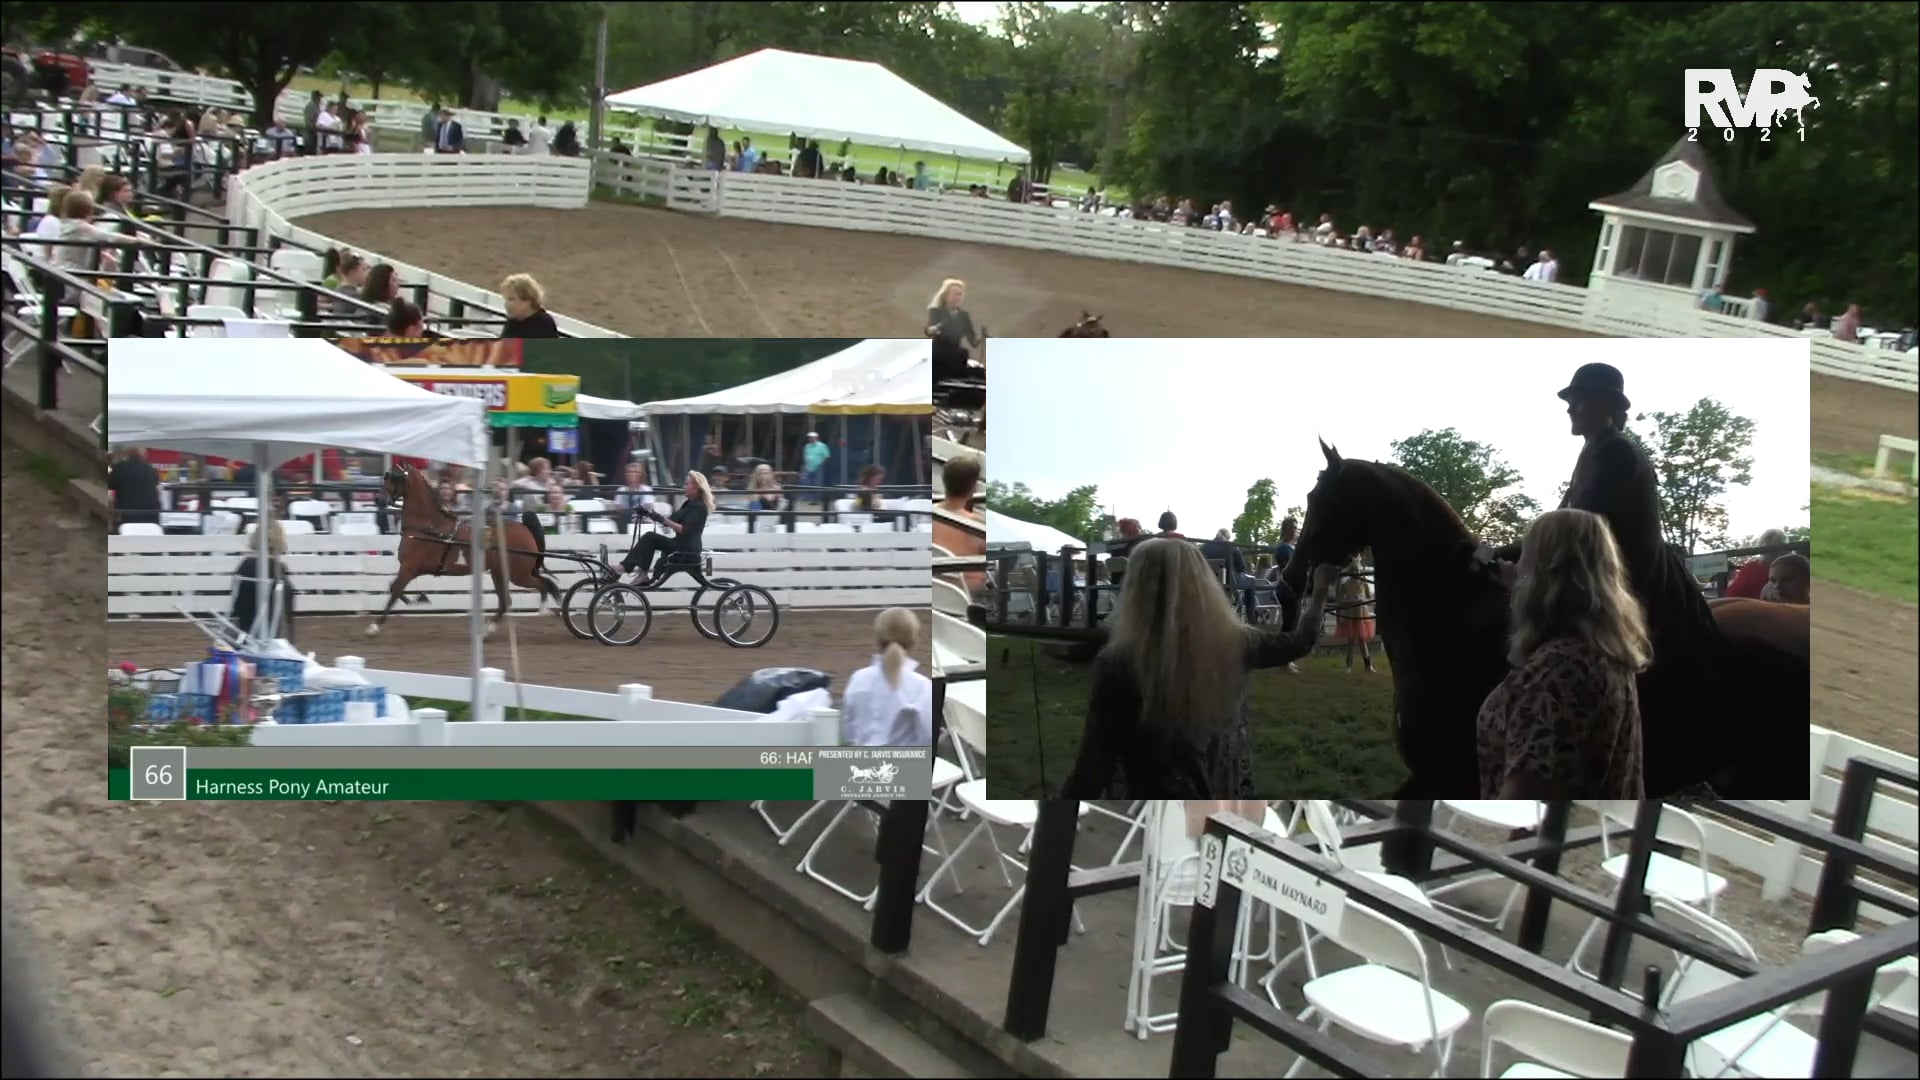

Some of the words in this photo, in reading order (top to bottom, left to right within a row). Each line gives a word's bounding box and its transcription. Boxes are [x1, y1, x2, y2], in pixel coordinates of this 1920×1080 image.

[1202, 842, 1217, 898] B22
[1252, 868, 1278, 892] DIANA
[1281, 883, 1327, 914] MAYNARD
